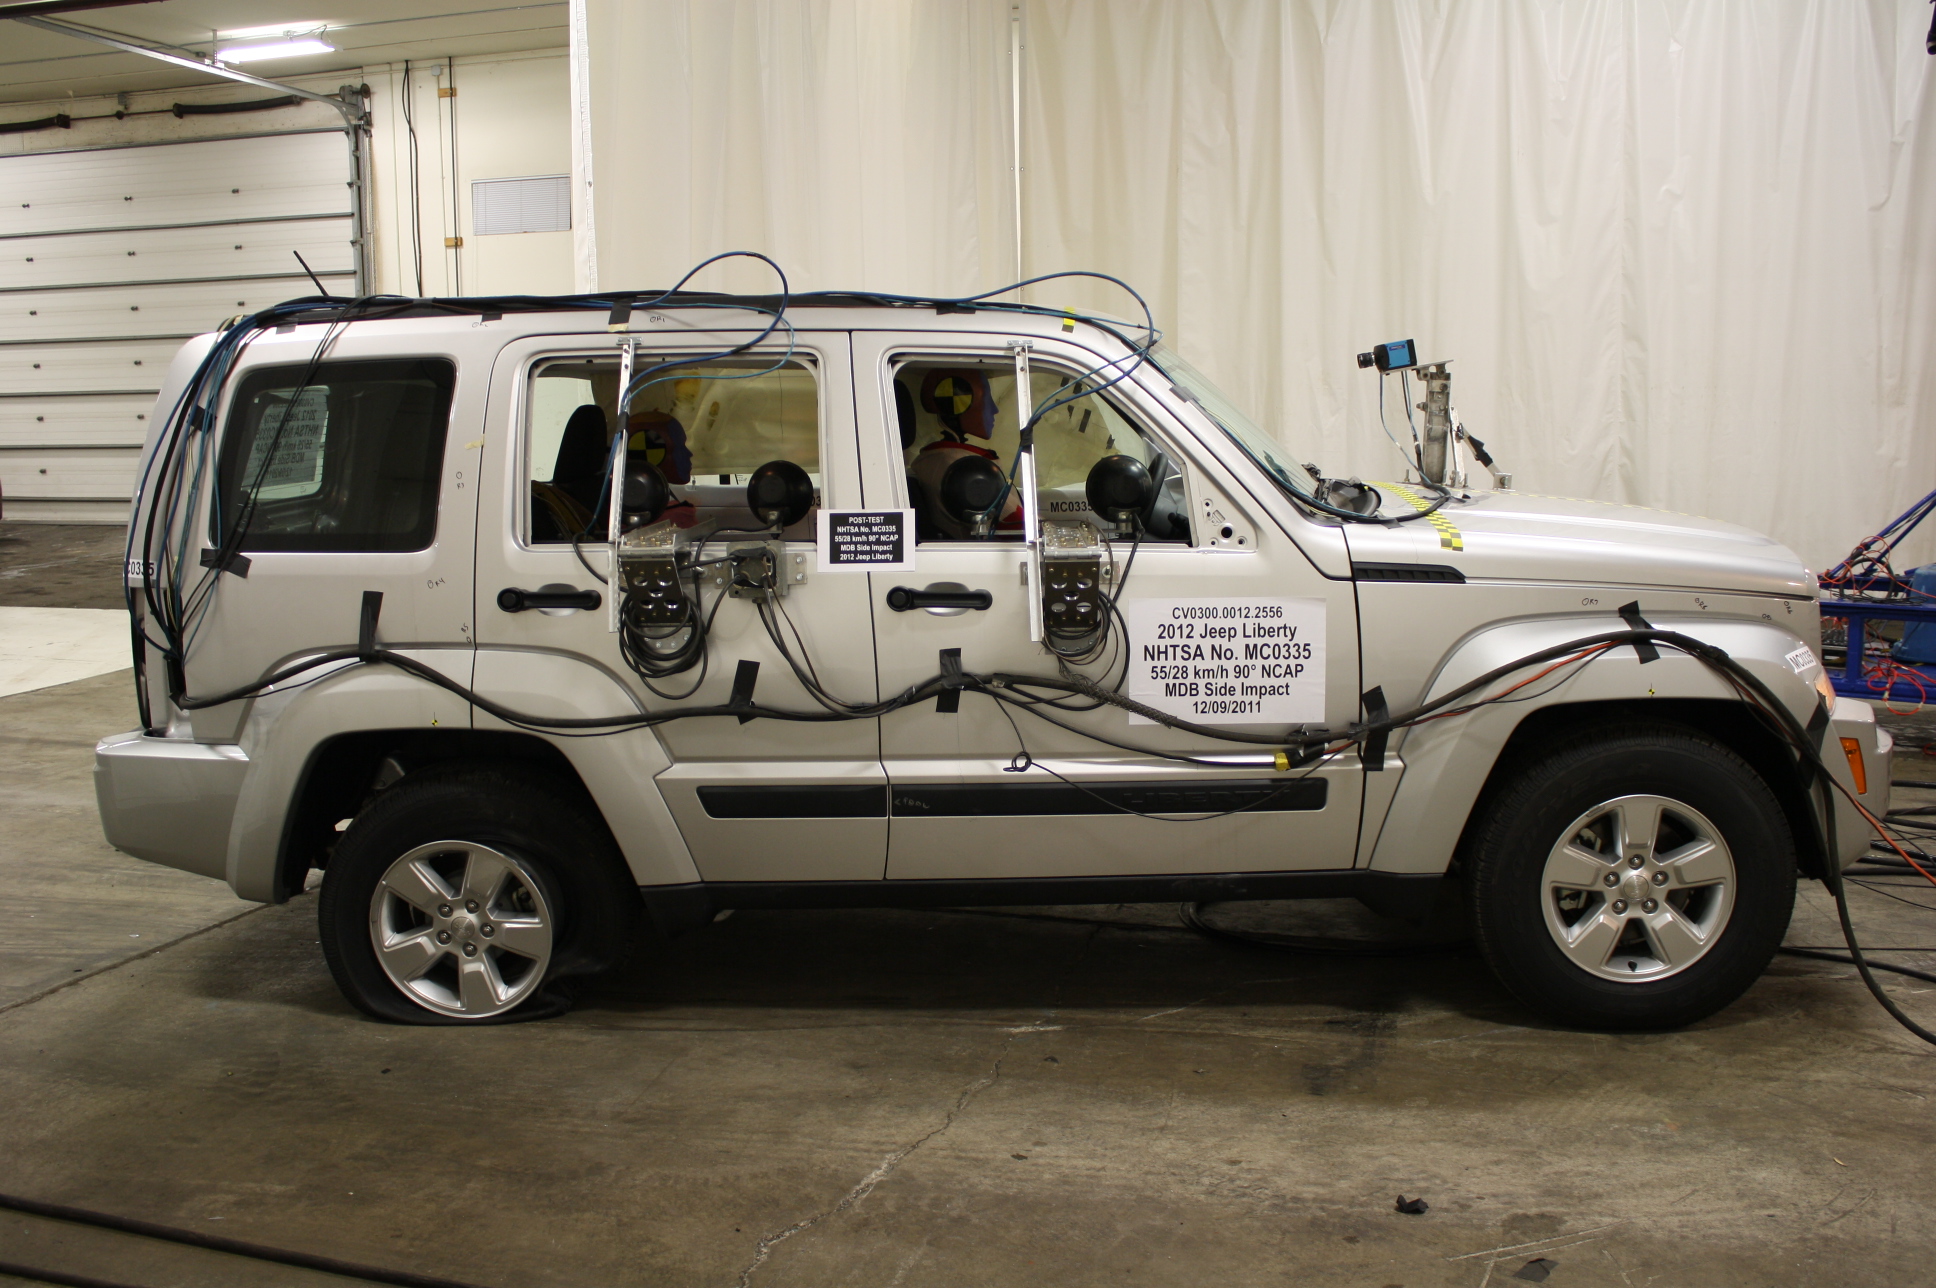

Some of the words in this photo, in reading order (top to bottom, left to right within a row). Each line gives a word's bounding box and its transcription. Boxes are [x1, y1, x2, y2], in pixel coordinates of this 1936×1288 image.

[848, 516, 885, 524] POST-TEST
[880, 534, 899, 542] NCAP
[871, 543, 893, 552] Impact
[856, 553, 870, 561] Jeep
[871, 553, 893, 561] Liberty
[1172, 606, 1283, 619] CV0300.0012.2556
[1157, 624, 1195, 639] 2012
[1199, 623, 1237, 642] Jeep
[1242, 623, 1297, 642] Liberty
[1143, 644, 1205, 661] NHTSA
[1210, 644, 1239, 661] No.
[1244, 643, 1312, 660] MC0335
[1150, 665, 1189, 680] 55/28
[1193, 665, 1229, 680] km/h
[1233, 664, 1257, 679] 90°
[1261, 663, 1304, 679] NCAP
[1165, 683, 1200, 697] MDB
[1204, 682, 1236, 697] Side
[1241, 682, 1290, 699] Impact
[1192, 700, 1261, 714] 12/09/2011
